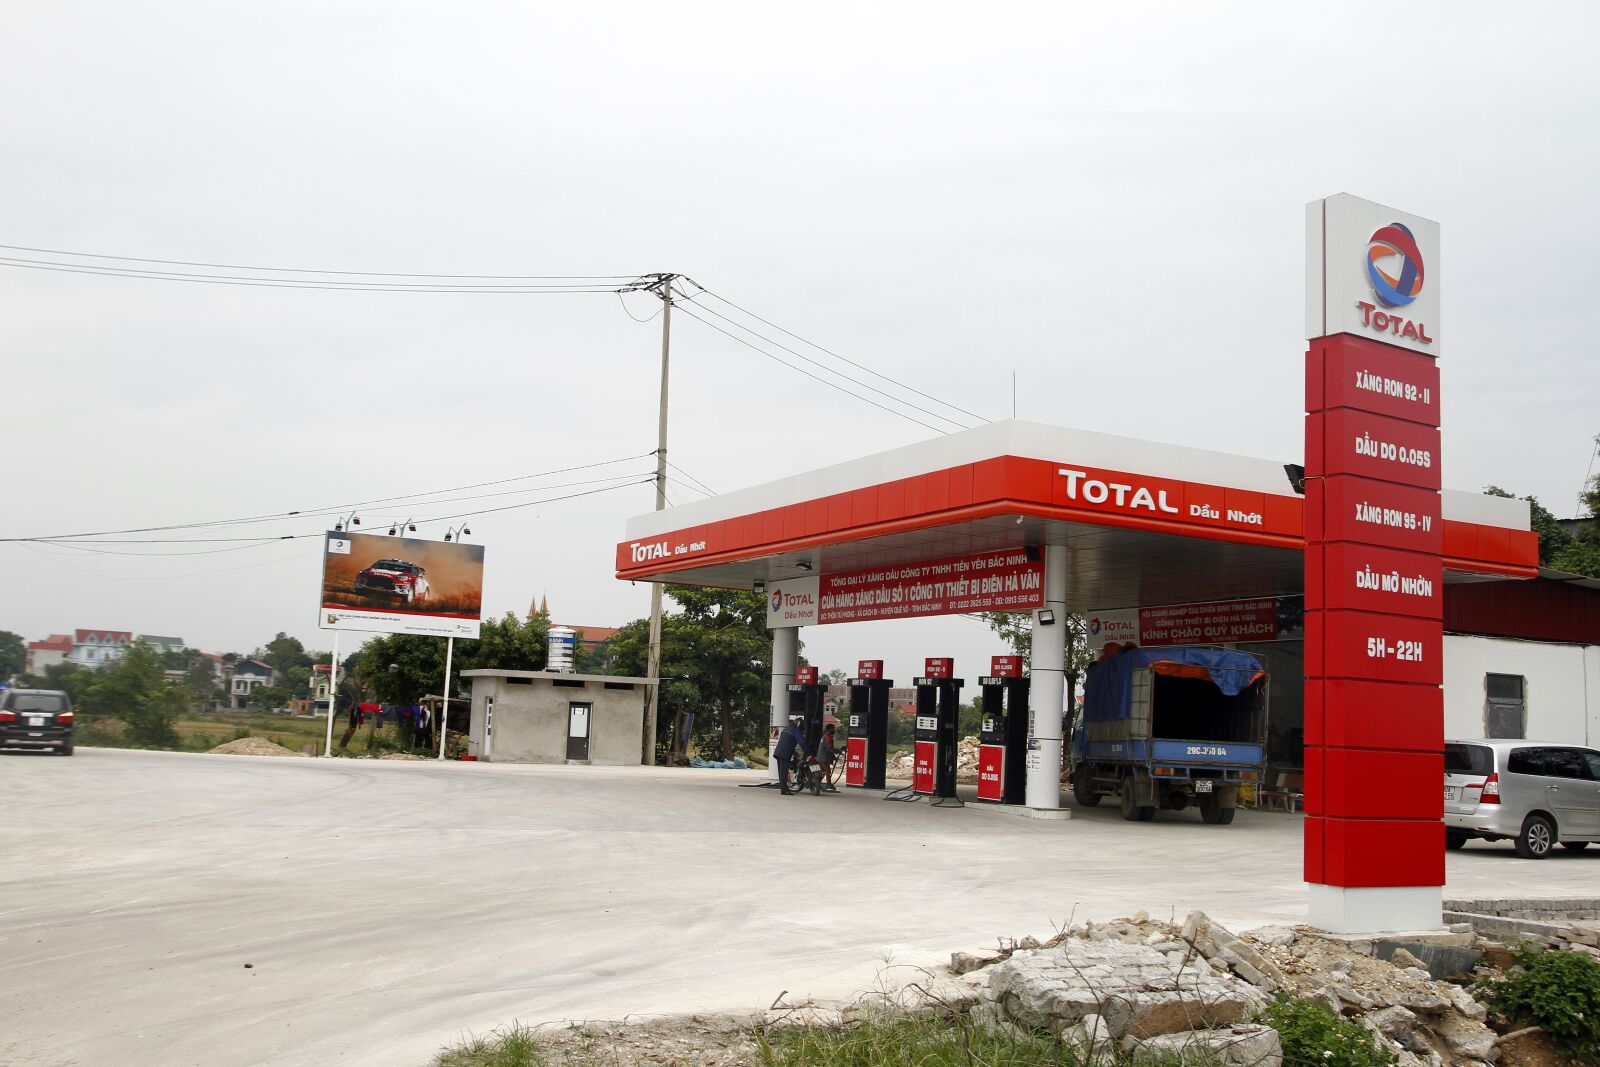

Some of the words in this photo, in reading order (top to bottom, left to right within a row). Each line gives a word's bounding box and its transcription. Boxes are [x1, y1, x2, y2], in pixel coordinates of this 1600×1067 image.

[1357, 299, 1433, 343] TOTAL
[1384, 378, 1403, 398] RON
[1405, 384, 1417, 401] 92
[1355, 431, 1378, 457] DẦU
[1380, 442, 1397, 461] DO
[1399, 446, 1431, 468] 0.05S
[1058, 468, 1179, 513] TOTAL
[1190, 504, 1220, 520] Dầu
[1227, 509, 1263, 525] Nhớt
[1383, 508, 1402, 528] RON
[1404, 512, 1416, 530] 95
[1422, 515, 1432, 532] IV
[630, 541, 672, 563] TOTAL
[858, 574, 866, 584] LÝ
[885, 568, 900, 581] DẦU
[900, 567, 920, 579] CÔNG
[922, 567, 930, 576] TY
[931, 564, 952, 575] TNHH
[988, 555, 1004, 568] BẮC
[1006, 555, 1028, 566] NINH
[1356, 564, 1380, 590] DẦU
[1381, 571, 1399, 593] MỠ
[1401, 574, 1432, 597] NHỜN
[783, 593, 814, 607] TOTAL
[821, 590, 835, 610] CỬA
[835, 590, 854, 608] HÀNG
[875, 583, 892, 605] DẦU
[892, 581, 903, 602] SỐ
[904, 587, 908, 601] 1
[909, 581, 933, 602] CÔNG
[934, 581, 945, 599] TY
[945, 574, 970, 597] THIẾT
[971, 578, 980, 599] BỊ
[981, 573, 1003, 597] ĐIỆN
[1005, 570, 1018, 591] HÀ
[1020, 568, 1040, 590] VÂN
[1102, 620, 1135, 631] TOTAL
[1142, 628, 1168, 640] KÍNH
[1170, 626, 1202, 638] CHÀO
[1204, 623, 1227, 637] QUÝ
[1231, 622, 1273, 635] KHÁCH
[1155, 618, 1174, 627] CÔNG
[1175, 618, 1183, 626] TY
[1230, 614, 1241, 622] HÀ
[1367, 637, 1385, 658] 5H
[1396, 640, 1422, 661] 22H
